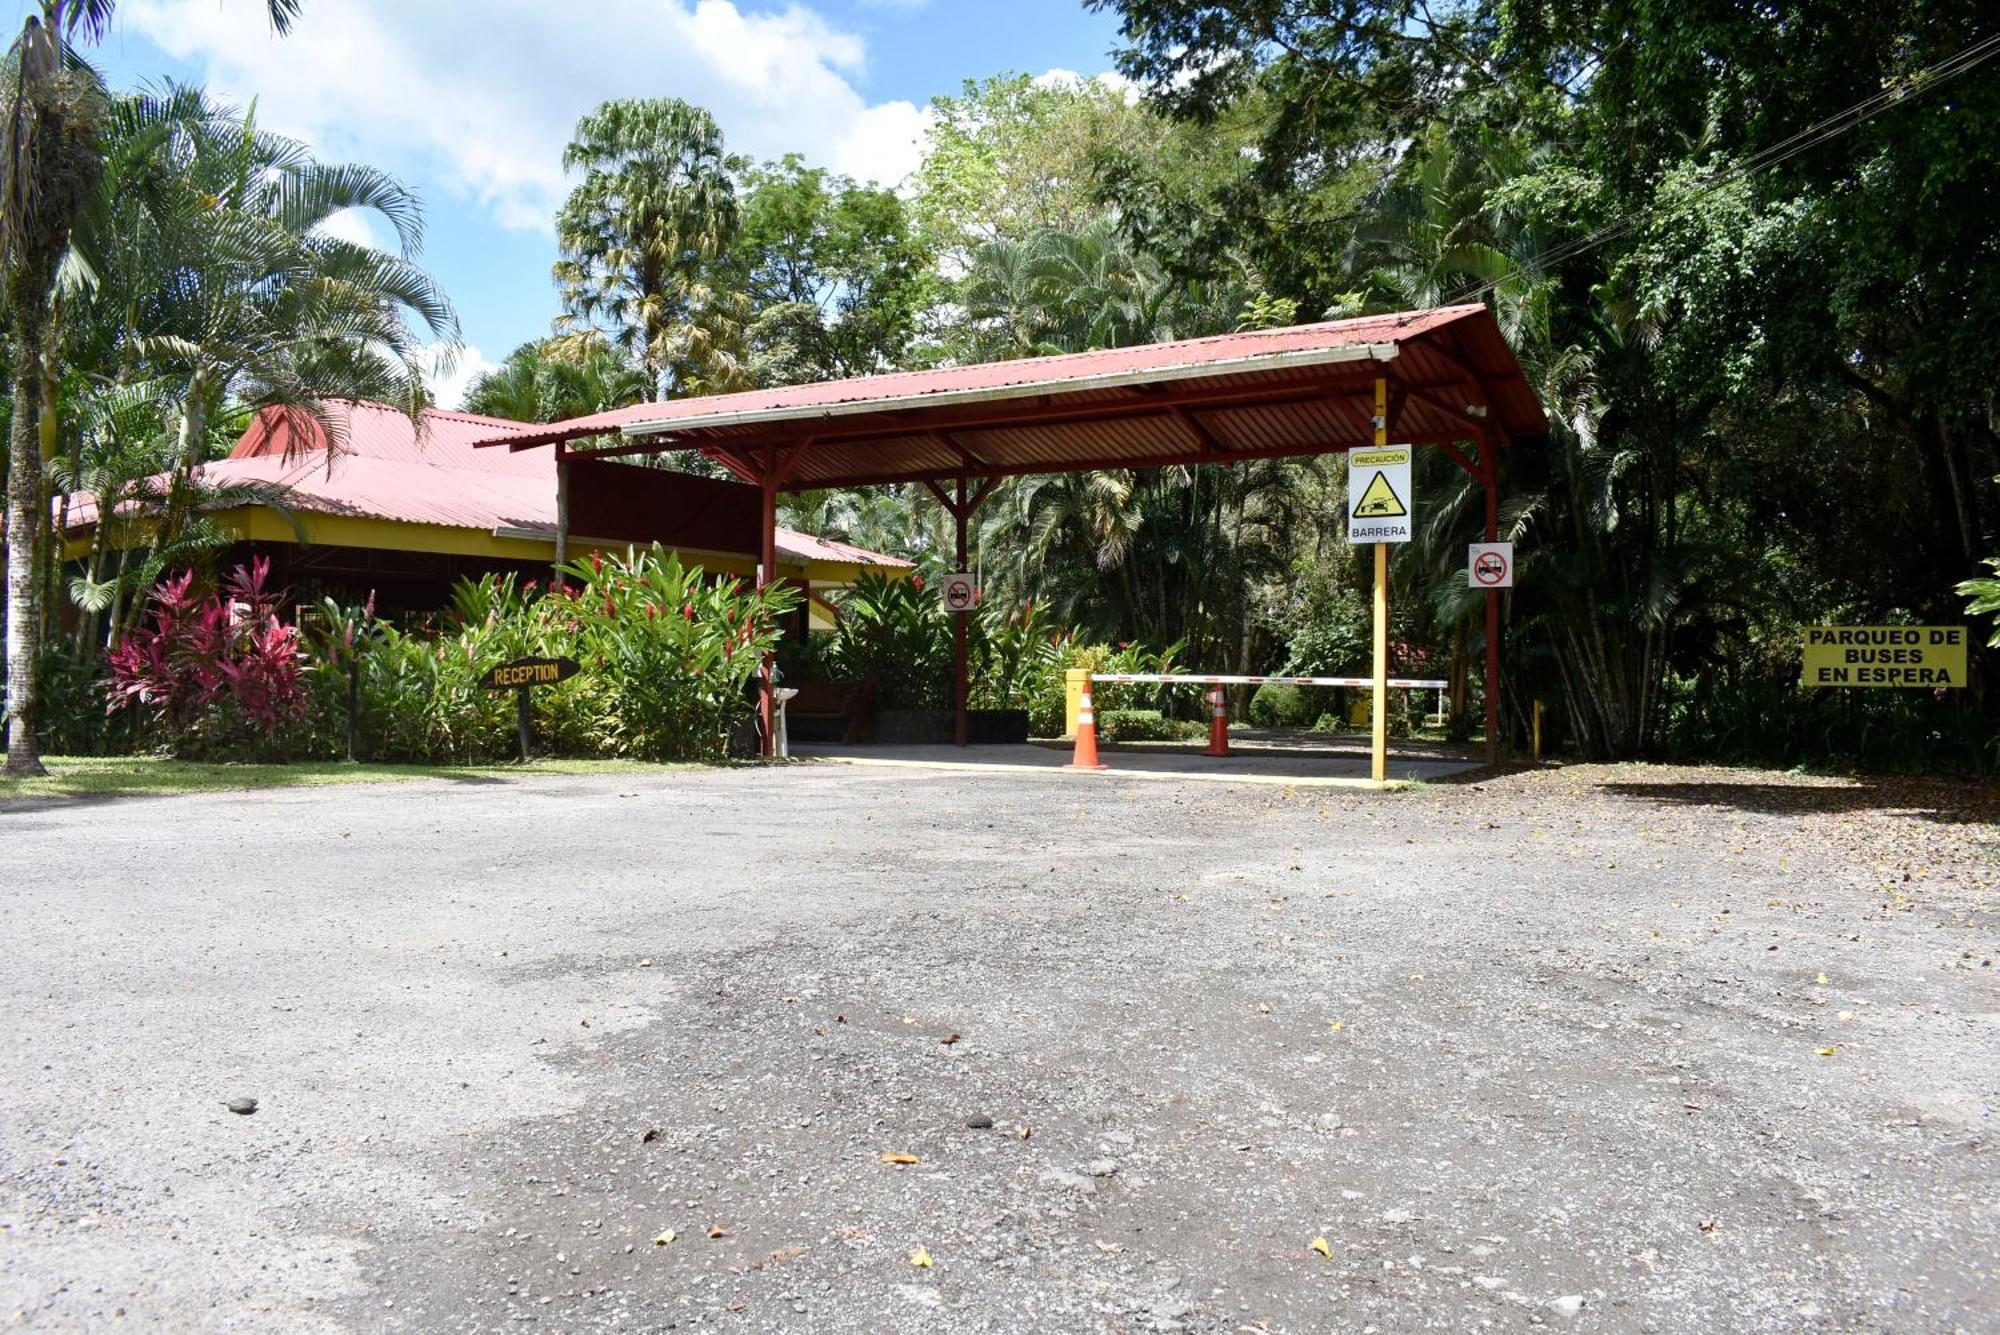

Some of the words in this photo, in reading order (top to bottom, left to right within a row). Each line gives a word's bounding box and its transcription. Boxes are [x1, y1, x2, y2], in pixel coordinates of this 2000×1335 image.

[1355, 454, 1405, 464] PRECAUCIÓN
[1352, 526, 1407, 538] BARRERA
[1809, 630, 1920, 645] PARQUEO
[1929, 630, 1960, 645] DE
[1845, 649, 1923, 664] BUSES
[494, 663, 559, 685] RECEPTION
[1818, 667, 1848, 682] EN
[1857, 667, 1952, 683] ESPERA
